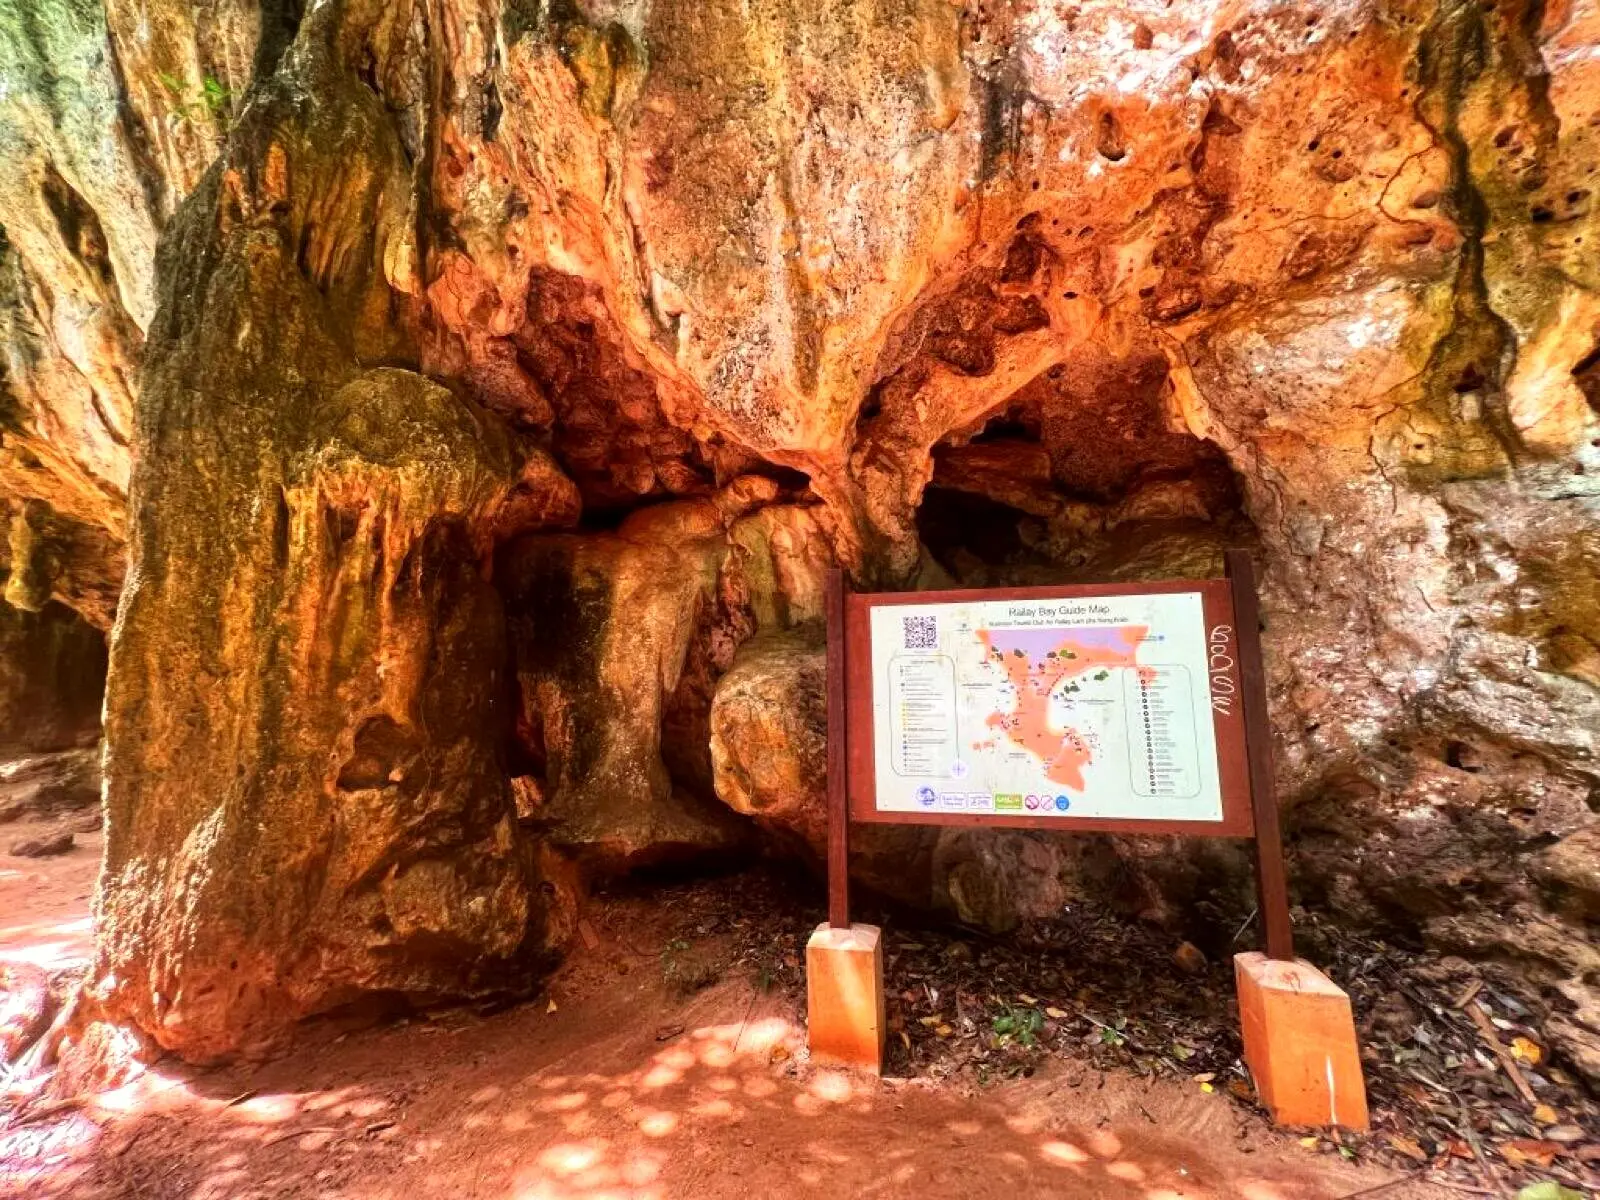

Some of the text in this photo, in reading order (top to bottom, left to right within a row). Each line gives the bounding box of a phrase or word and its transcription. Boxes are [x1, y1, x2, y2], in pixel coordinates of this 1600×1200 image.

[1009, 604, 1110, 618] Railay Bay Guide Map
